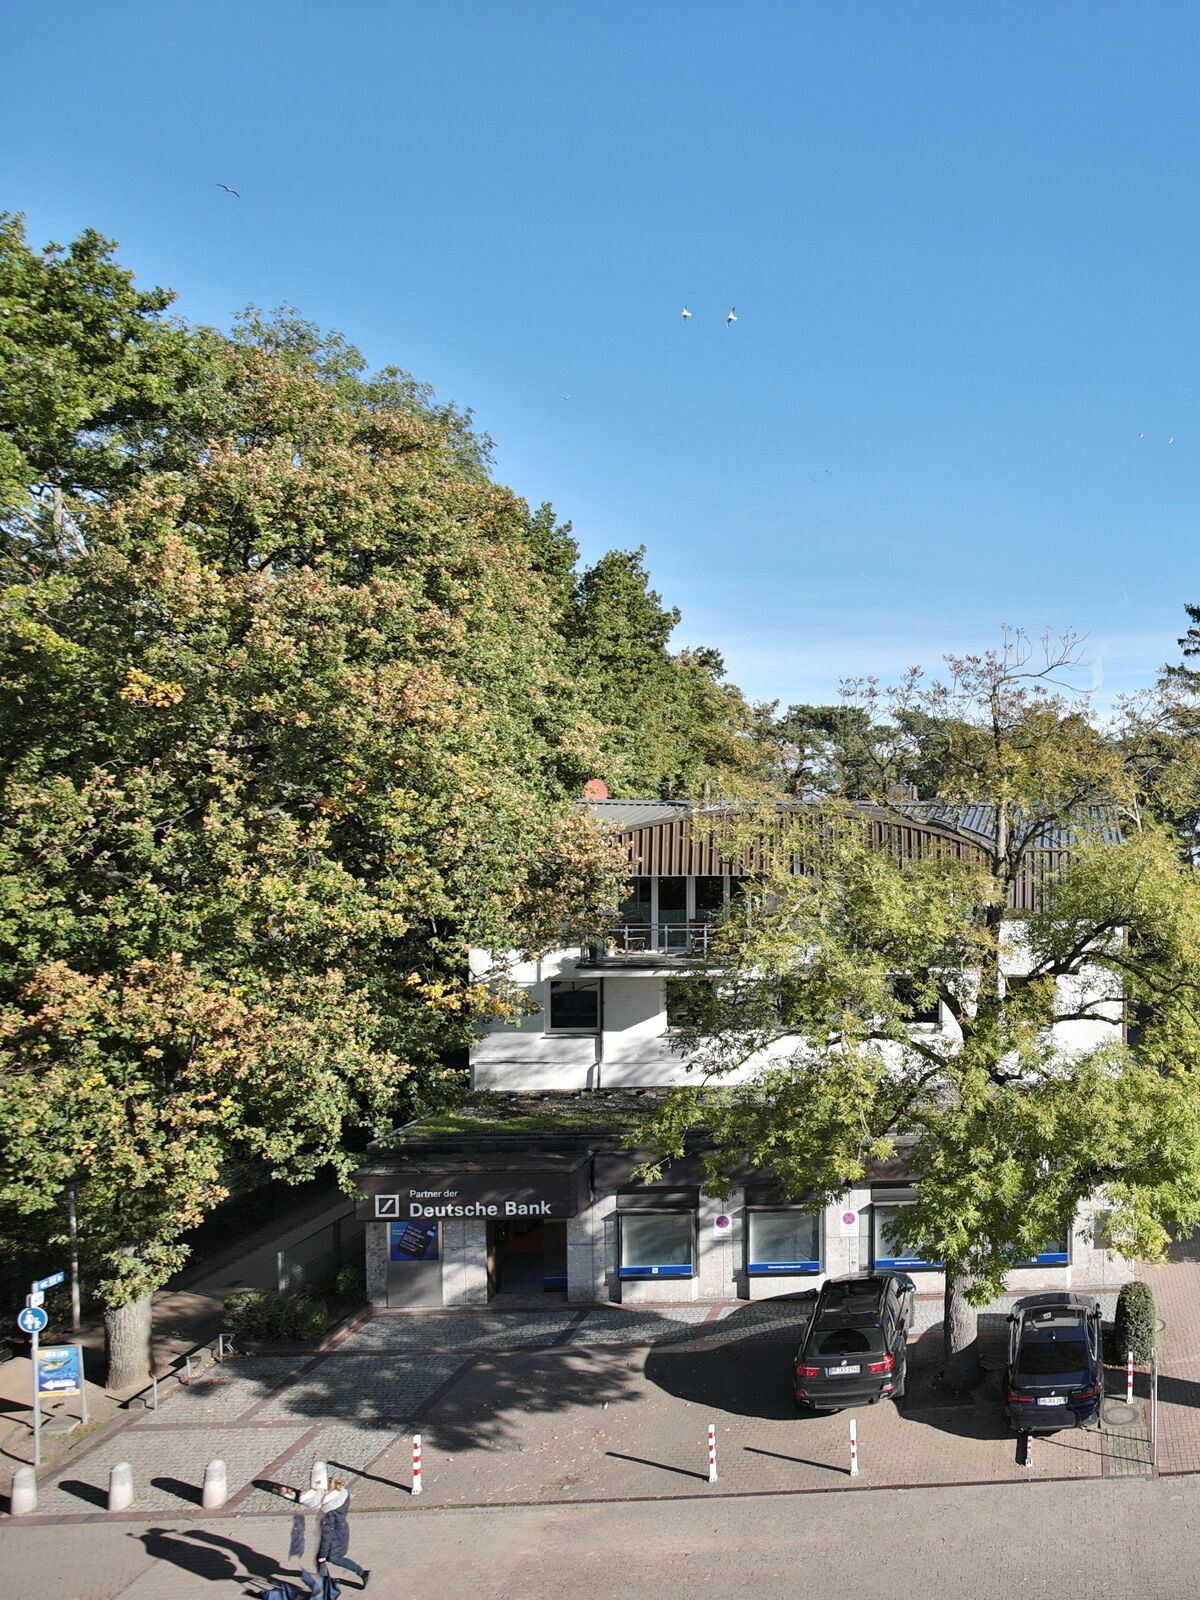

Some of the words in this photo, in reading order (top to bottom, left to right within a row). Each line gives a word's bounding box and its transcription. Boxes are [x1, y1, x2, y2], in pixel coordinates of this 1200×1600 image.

[409, 1189, 442, 1198] Partner
[443, 1189, 458, 1198] der
[409, 1202, 498, 1217] Deutsche
[505, 1200, 552, 1216] Bank
